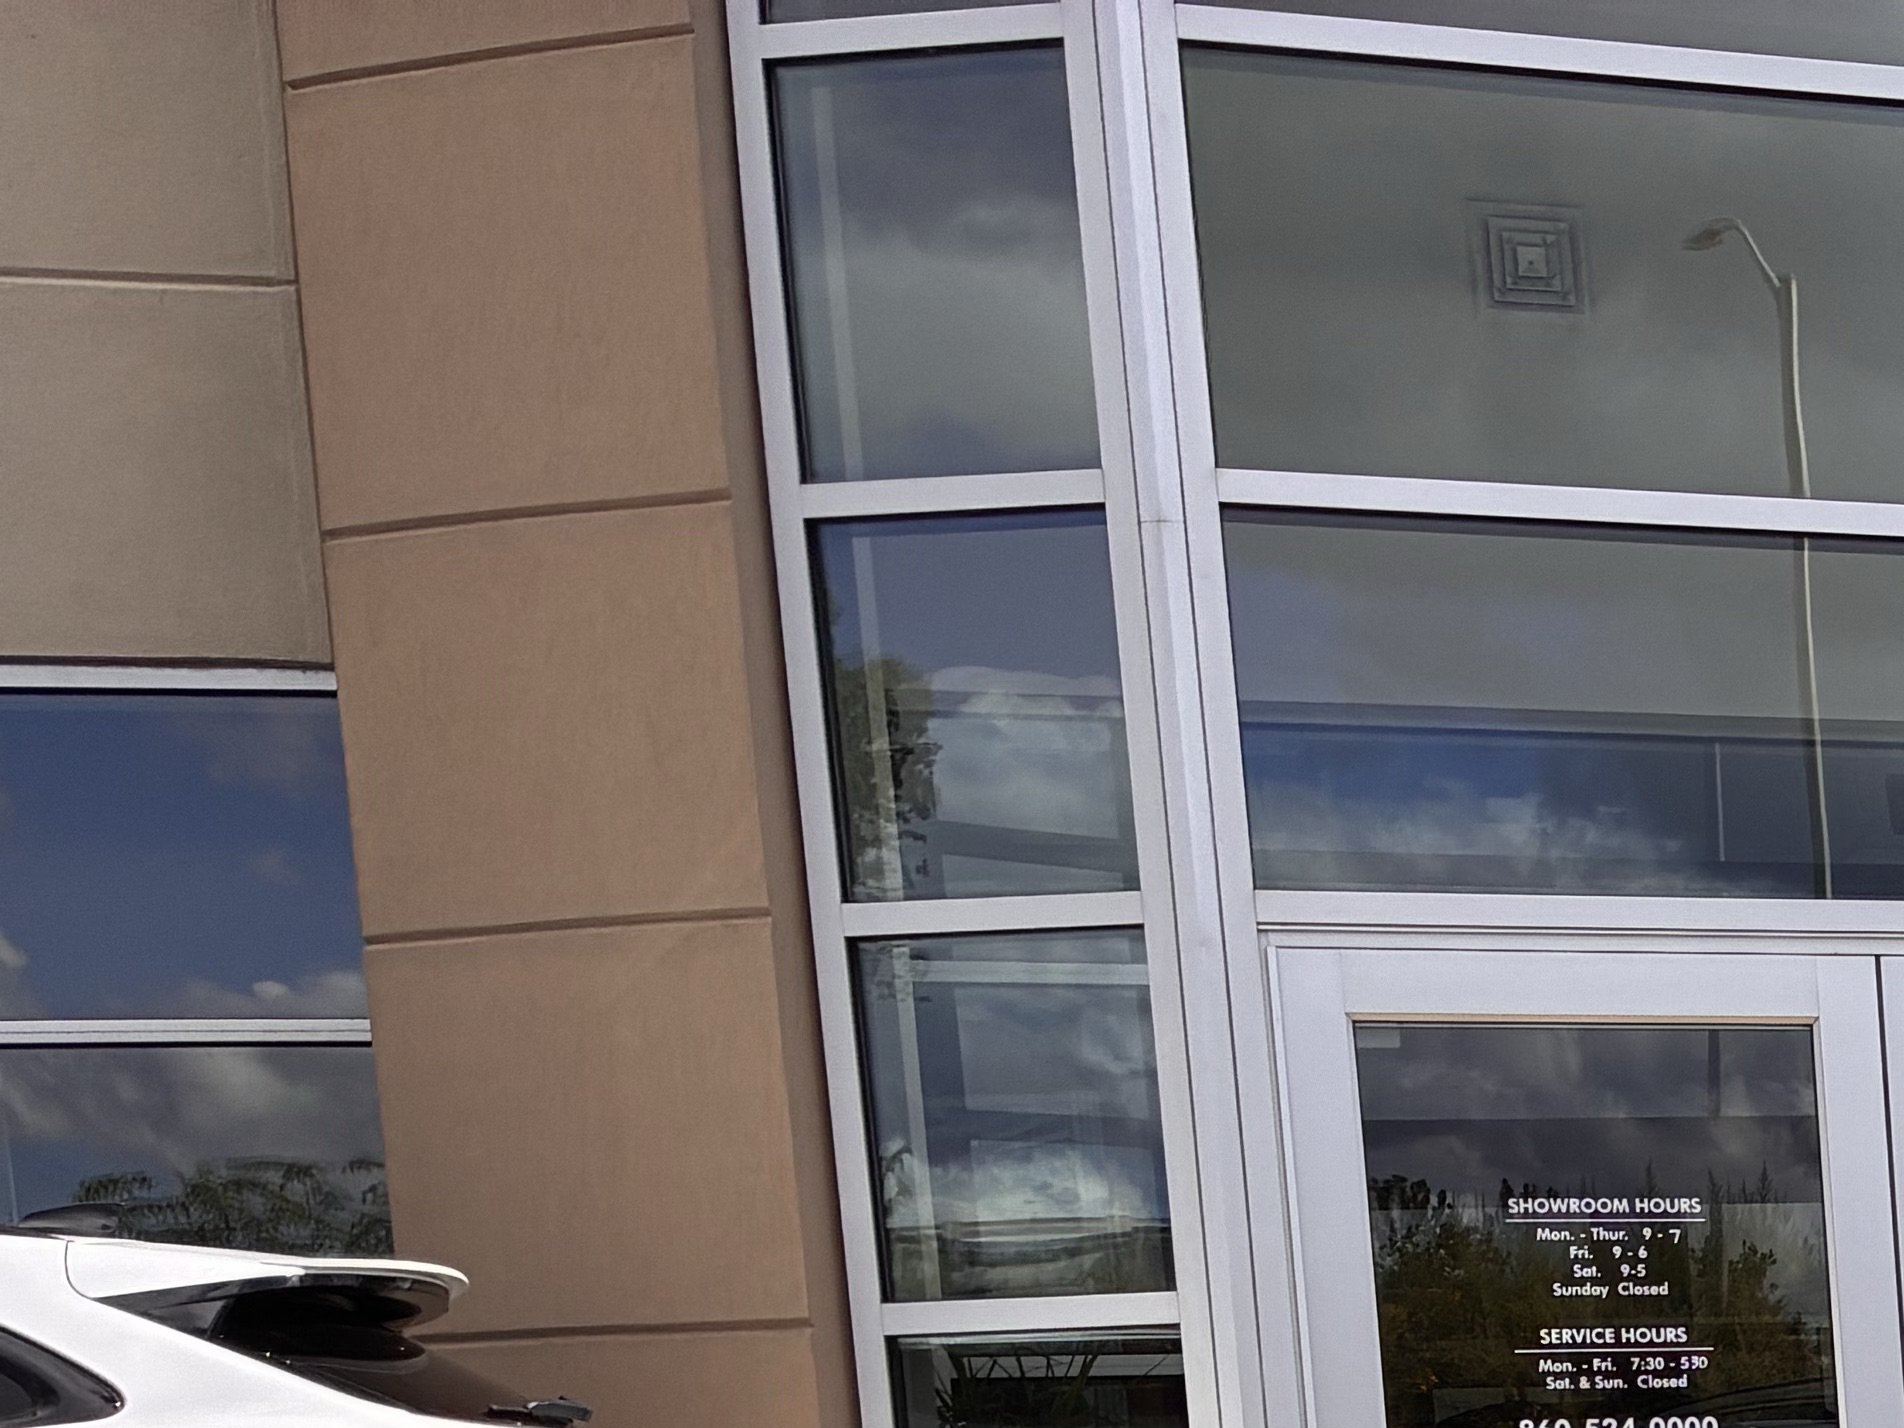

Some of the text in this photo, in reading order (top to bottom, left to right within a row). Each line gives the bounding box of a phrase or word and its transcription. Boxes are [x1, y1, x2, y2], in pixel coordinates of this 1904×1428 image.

[1507, 1197, 1702, 1214] SHOWROOM HOURS
[1536, 1227, 1575, 1241] Mon.
[1590, 1227, 1629, 1241] Thur.
[1642, 1227, 1652, 1241] 9
[1668, 1228, 1682, 1244] 7
[1569, 1245, 1594, 1259] Fri.
[1612, 1245, 1623, 1259] 9
[1637, 1245, 1648, 1259] 6
[1573, 1264, 1602, 1278] Sat.
[1552, 1282, 1669, 1299] Sunday Closed
[1539, 1327, 1688, 1345] SERVICE HOURS
[1538, 1359, 1577, 1373] Mon.
[1592, 1358, 1617, 1372] Fri.
[1630, 1357, 1665, 1371] 7:30
[1545, 1374, 1688, 1390] Sat. & Sun. Closed
